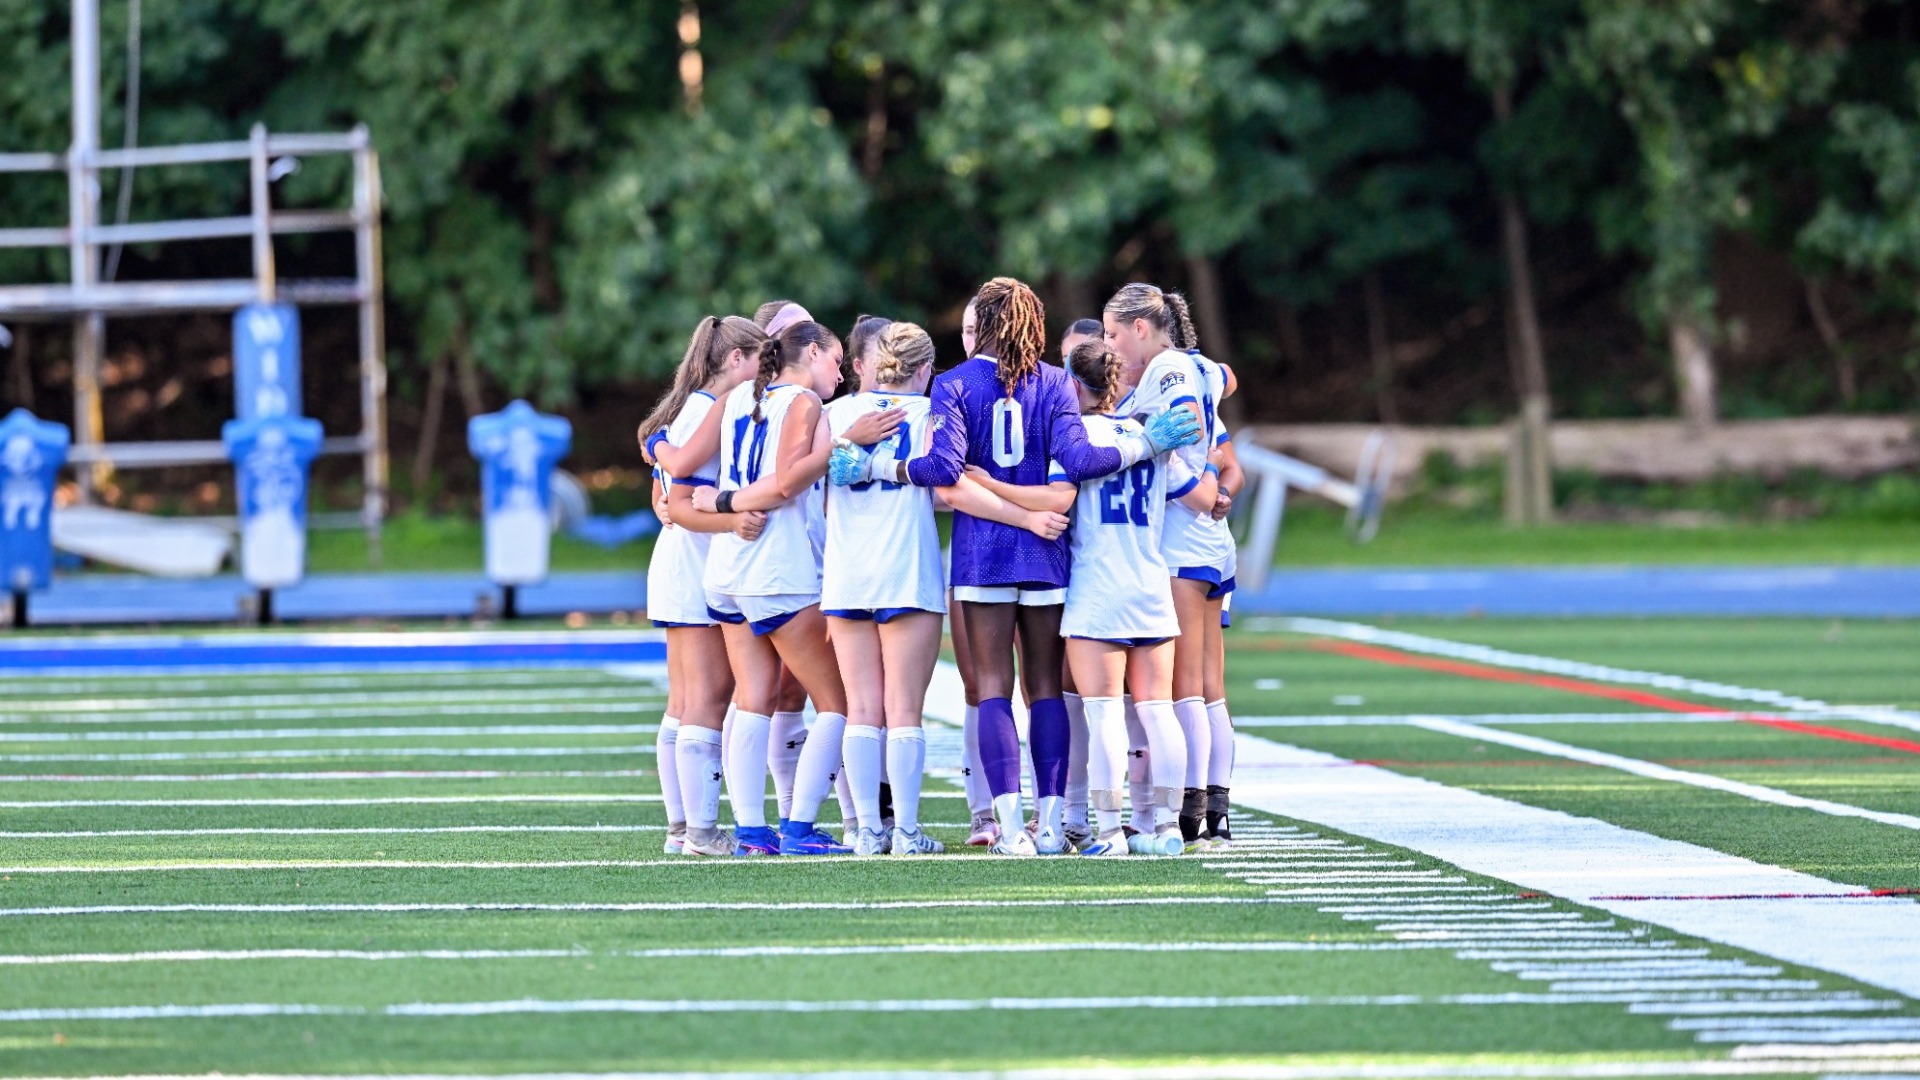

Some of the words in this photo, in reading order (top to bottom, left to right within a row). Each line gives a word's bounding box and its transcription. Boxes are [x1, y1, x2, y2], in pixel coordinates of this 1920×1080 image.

[729, 413, 769, 488] 10
[992, 397, 1024, 468] 0
[1100, 459, 1155, 527] 28
